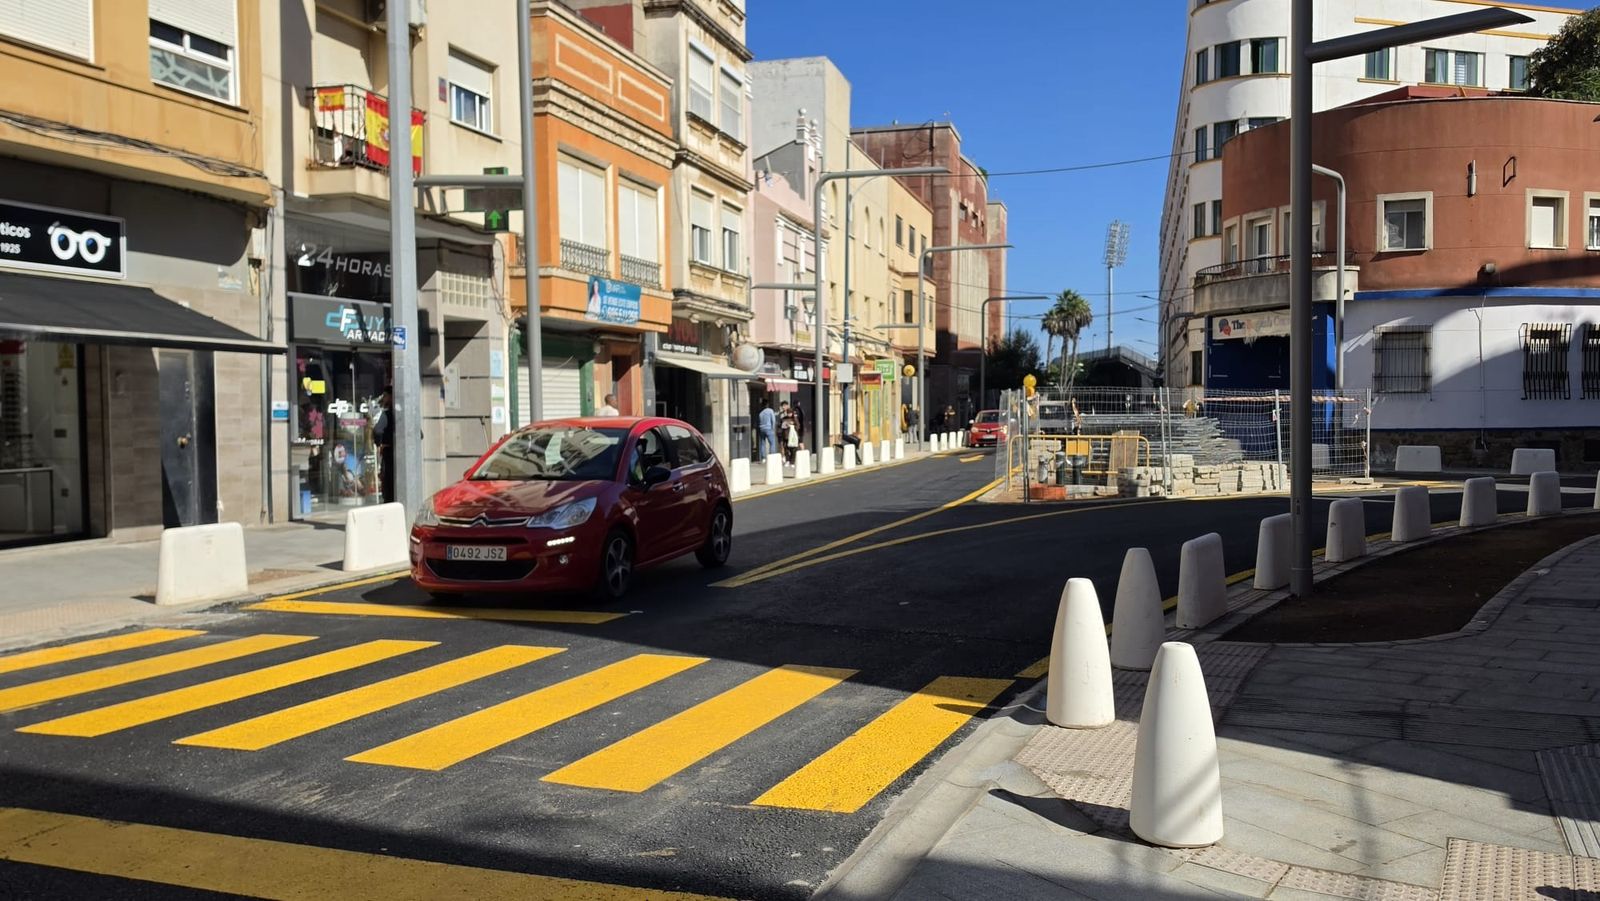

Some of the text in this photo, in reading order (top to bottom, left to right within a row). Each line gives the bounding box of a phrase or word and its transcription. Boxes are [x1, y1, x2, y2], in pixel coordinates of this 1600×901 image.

[0, 242, 21, 254] 1925
[1231, 320, 1246, 331] The
[453, 547, 504, 559] 0492 JSZ
